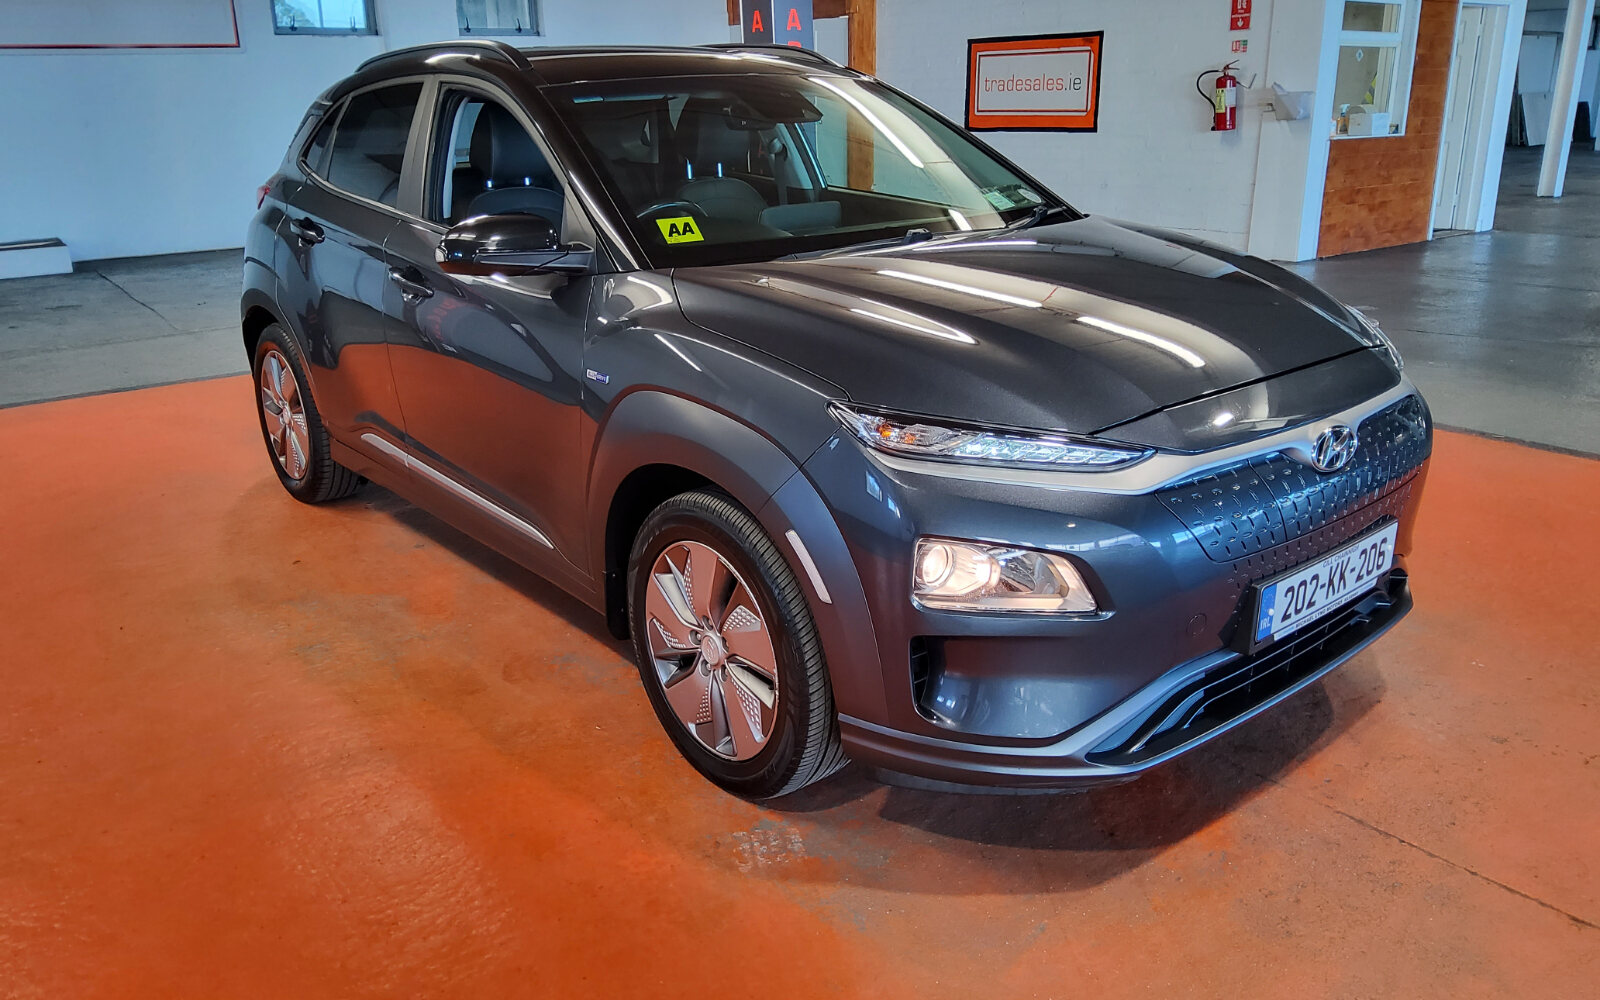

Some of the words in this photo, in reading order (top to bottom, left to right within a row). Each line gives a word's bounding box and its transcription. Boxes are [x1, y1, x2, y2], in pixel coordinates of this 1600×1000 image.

[752, 10, 764, 33] A
[787, 8, 802, 31] A
[984, 73, 1082, 92] tradesales.ie
[668, 222, 695, 237] AA
[1280, 537, 1388, 623] 202-KK-206
[1260, 616, 1271, 630] IRL
